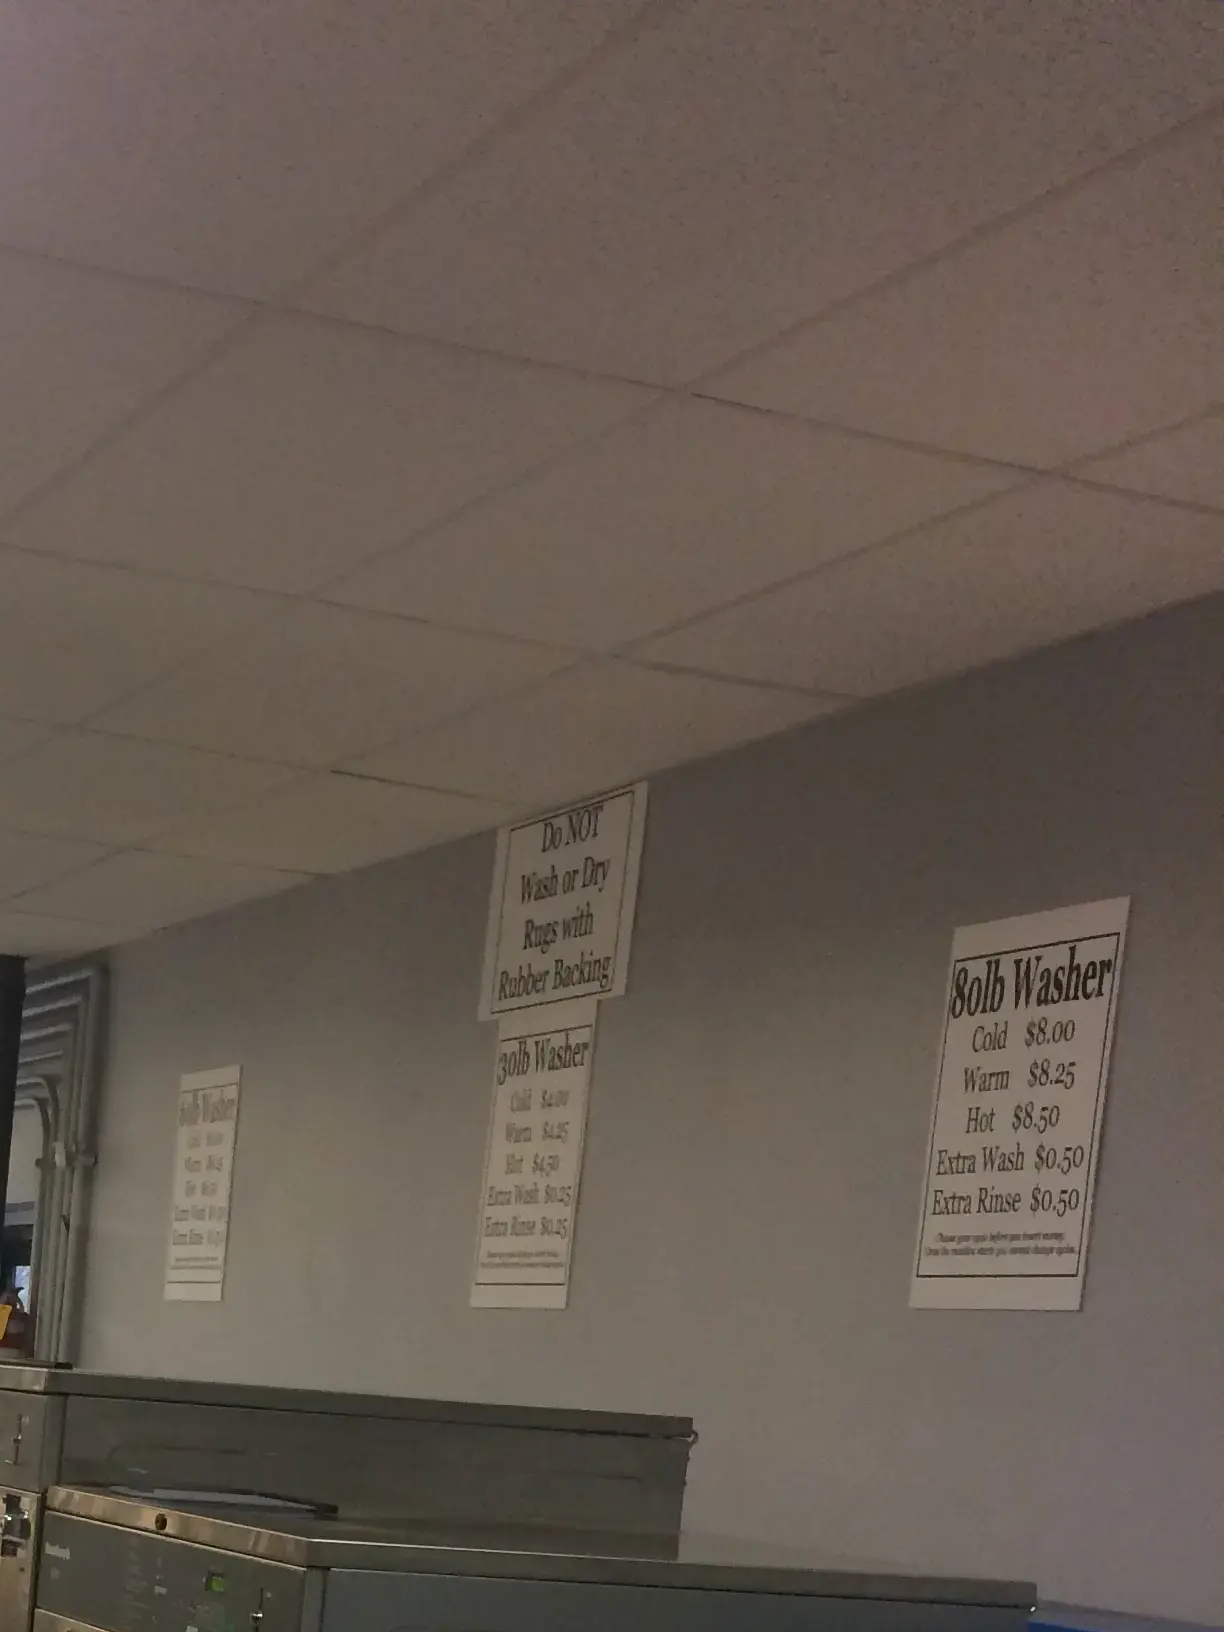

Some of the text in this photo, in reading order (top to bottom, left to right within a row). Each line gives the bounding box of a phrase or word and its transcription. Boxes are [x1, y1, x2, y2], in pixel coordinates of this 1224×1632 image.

[541, 804, 605, 853] Do NOT
[520, 856, 611, 904] Wash or Dry
[523, 901, 594, 955] Rugs with
[498, 950, 613, 1000] Rubber Backing
[951, 945, 1113, 1019] 80lb Washer
[534, 1032, 589, 1073] Washer
[972, 1016, 1075, 1053] Cold $8.00
[963, 1058, 1077, 1094] Warm $8.25
[965, 1101, 1061, 1134] Hot $8.50
[936, 1142, 1084, 1176] Extra Wash $0.50
[931, 1182, 1080, 1217] Extra Rinse $0.50
